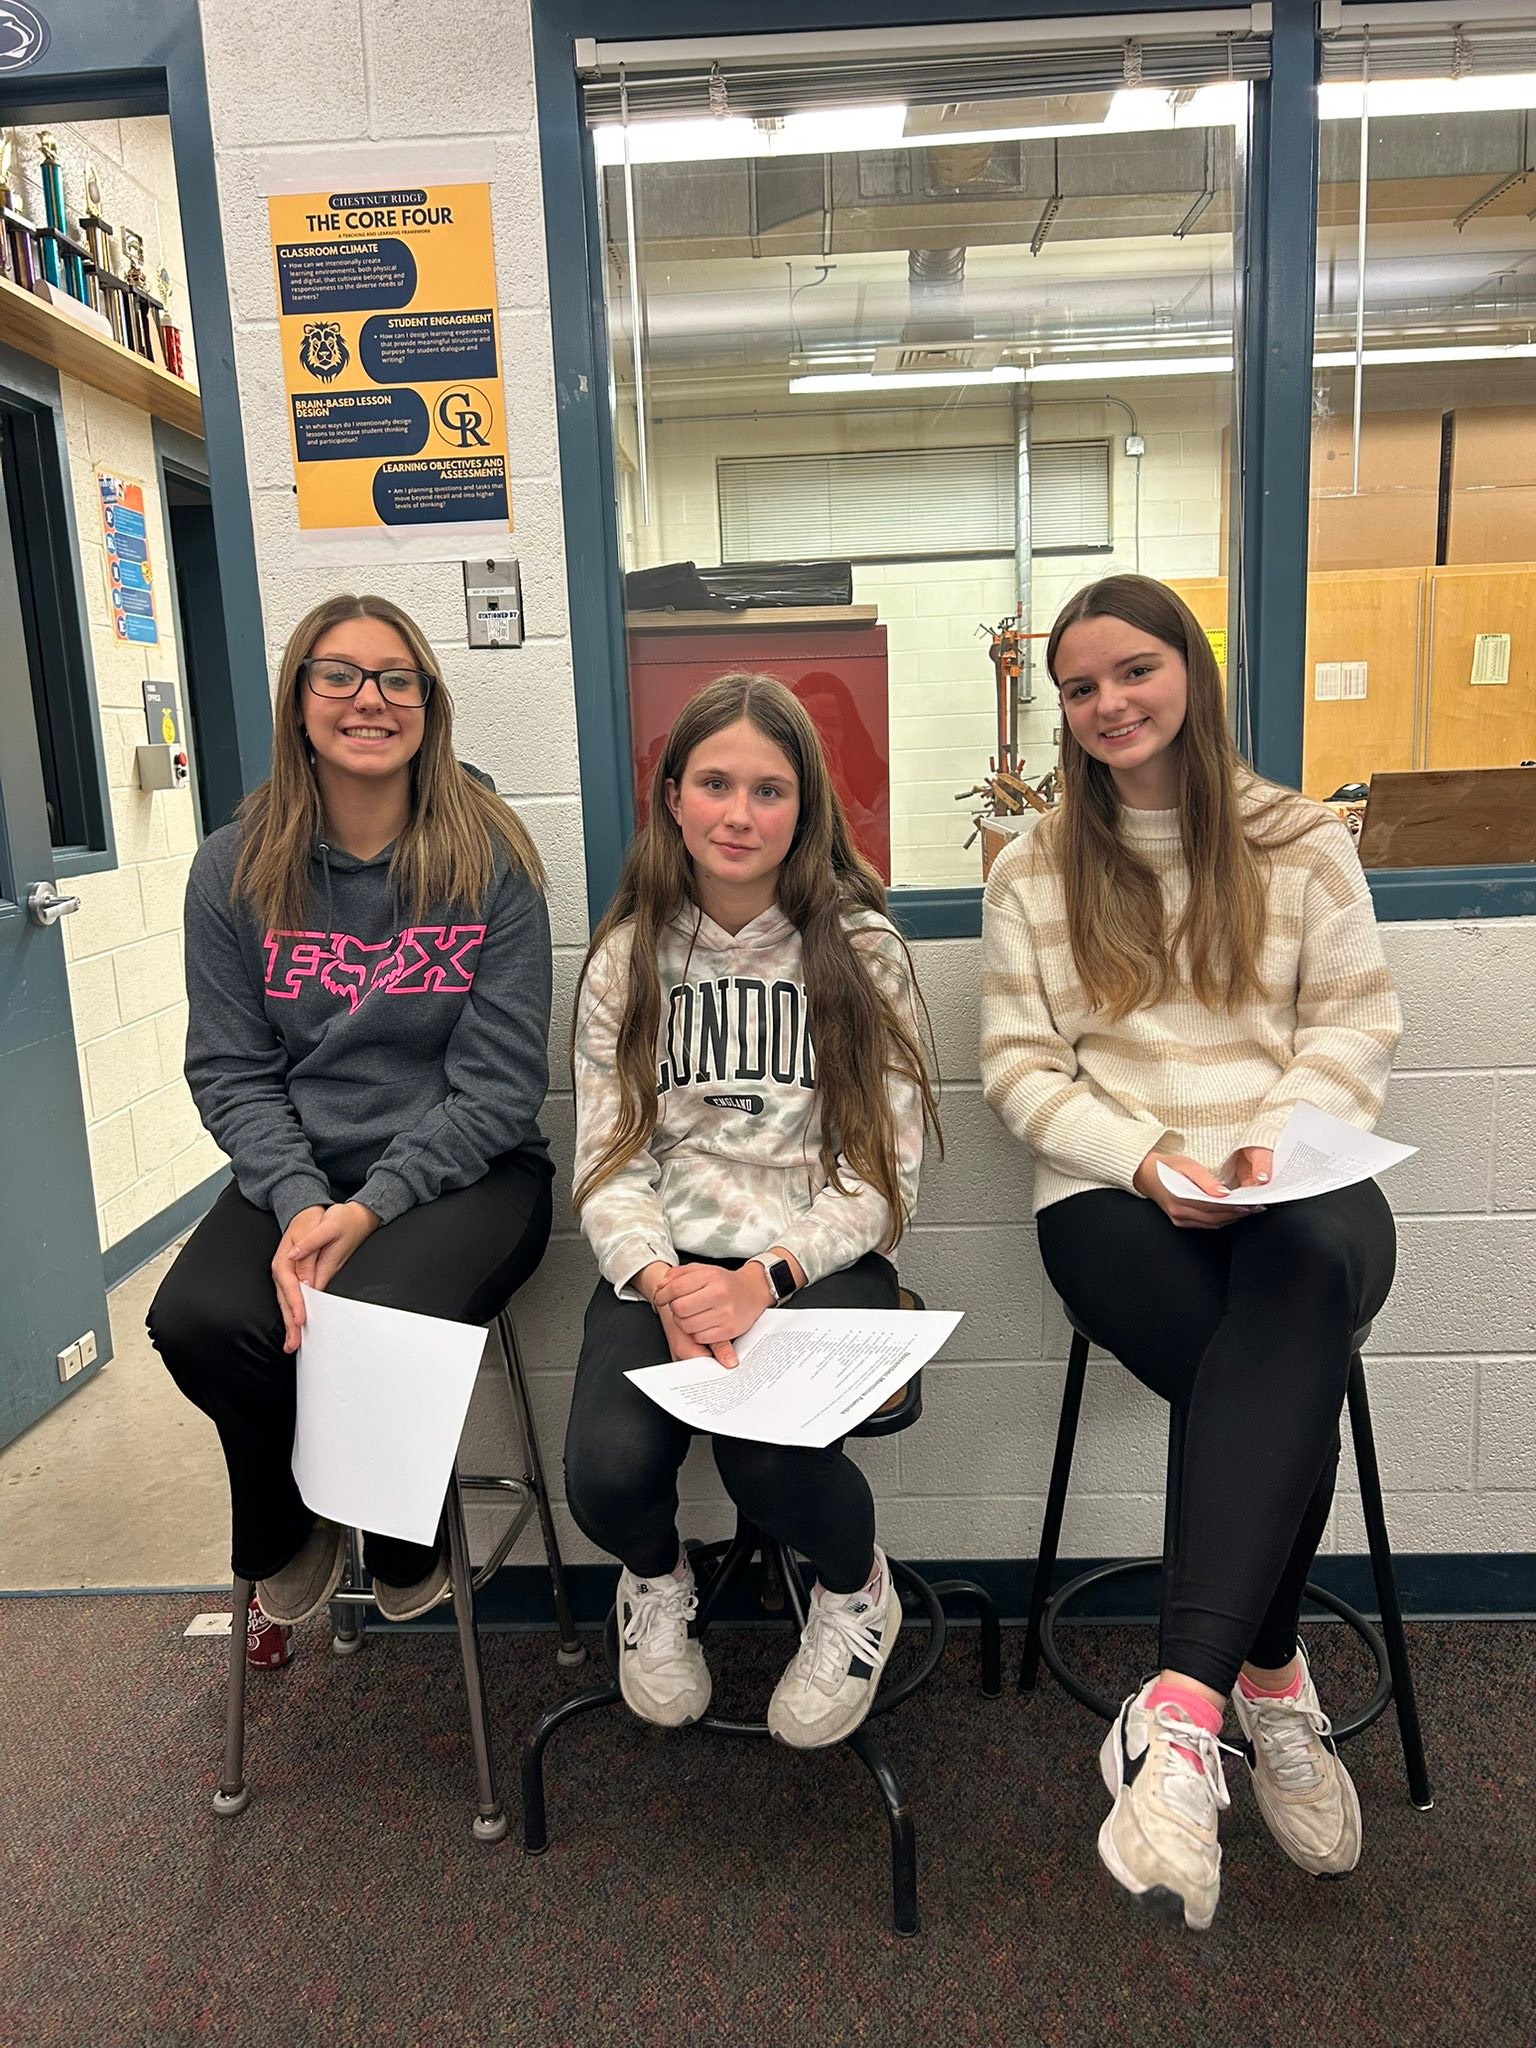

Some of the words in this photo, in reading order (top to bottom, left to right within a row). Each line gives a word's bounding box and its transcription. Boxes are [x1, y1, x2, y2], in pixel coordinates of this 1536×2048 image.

[332, 195, 388, 207] CHESTNUT
[391, 193, 424, 204] RIDGE
[306, 214, 340, 232] THE
[345, 210, 397, 229] CORE
[402, 207, 454, 226] FOUR
[280, 246, 338, 258] CLASSROOM
[340, 243, 378, 254] CLIMATE
[325, 258, 361, 267] intentionally
[290, 270, 314, 278] learning
[373, 265, 397, 273] physical
[363, 273, 392, 282] belonging
[291, 285, 336, 293] responsiveness
[388, 317, 429, 328] STUDENT
[430, 313, 492, 326] ENGAGEMENT
[430, 330, 454, 338] learning
[455, 328, 490, 336] experiences
[417, 338, 450, 346] meaningful
[440, 345, 466, 353] dialogue
[382, 356, 405, 364] writing?
[295, 399, 355, 409] BRAIN-BASED
[356, 395, 392, 406] LESSON
[296, 408, 330, 418] DESIGN
[392, 418, 412, 426] design
[439, 393, 490, 448] CR
[384, 426, 408, 434] thinking
[319, 436, 359, 446] participation?
[382, 461, 428, 473] LEARNING
[429, 459, 482, 471] OBJECTIVES
[483, 458, 503, 468] AND
[440, 468, 504, 480] ASSESSMENTS
[434, 485, 462, 493] questions
[411, 494, 433, 502] beyond
[476, 491, 495, 499] higher
[713, 1097, 752, 1112] ENGLAND
